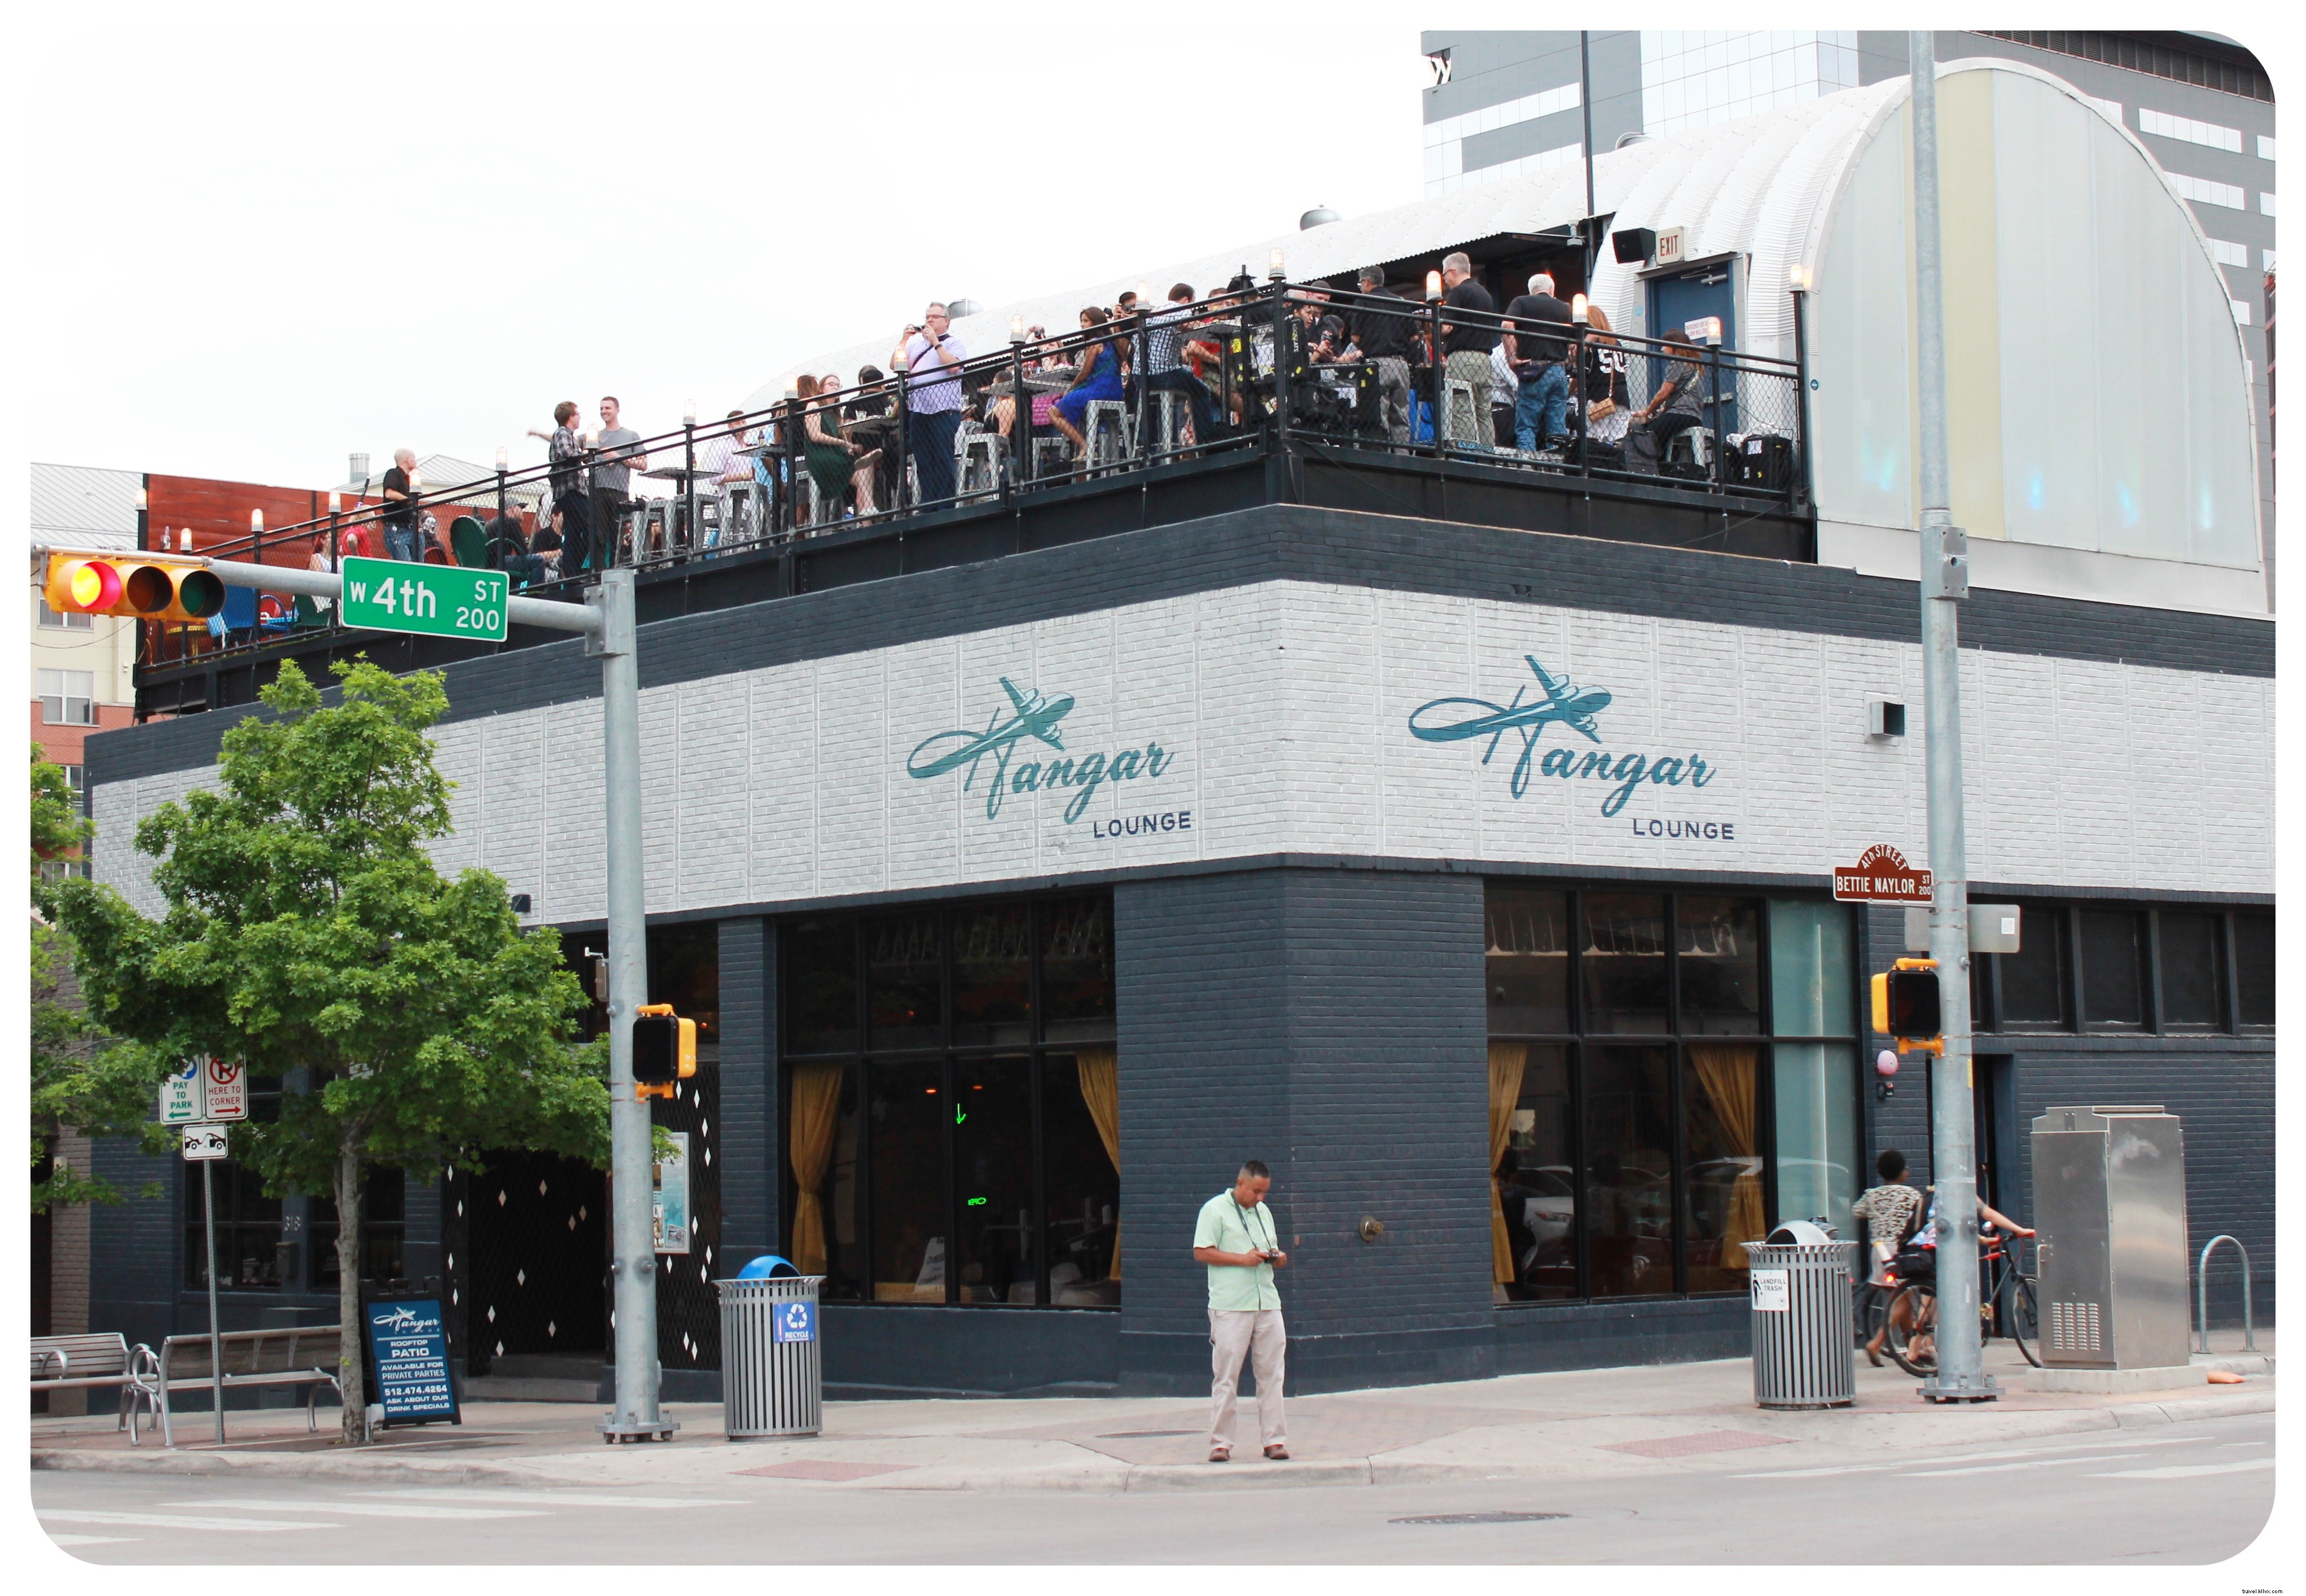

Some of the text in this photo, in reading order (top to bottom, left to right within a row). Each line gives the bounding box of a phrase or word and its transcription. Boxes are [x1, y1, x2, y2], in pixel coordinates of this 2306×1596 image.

[1427, 56, 1452, 86] W
[1660, 235, 1678, 257] EXIT
[349, 577, 502, 619] W 4th ST
[455, 606, 500, 631] 200
[1408, 655, 1716, 817] Hangar
[907, 677, 1174, 825] Hangar
[1093, 810, 1192, 839] LOUNGE
[1633, 818, 1735, 840] LOUNGE
[1861, 844, 1908, 871] 4th STREET
[1836, 876, 1915, 894] BETTIE NAYLOR
[1922, 875, 1930, 884] ST
[1919, 885, 1931, 895] 200
[173, 1081, 189, 1089] PAY
[208, 1085, 241, 1095] HERE TO
[176, 1091, 186, 1099] TO
[210, 1096, 241, 1106] CORNER
[170, 1100, 193, 1110] PARK
[373, 1306, 440, 1332] Hangar
[391, 1347, 429, 1358] PATIO
[381, 1362, 426, 1371] AVAILABLE
[382, 1369, 445, 1380] PRIVATE PARTIES
[384, 1384, 448, 1396] 512.474.4264
